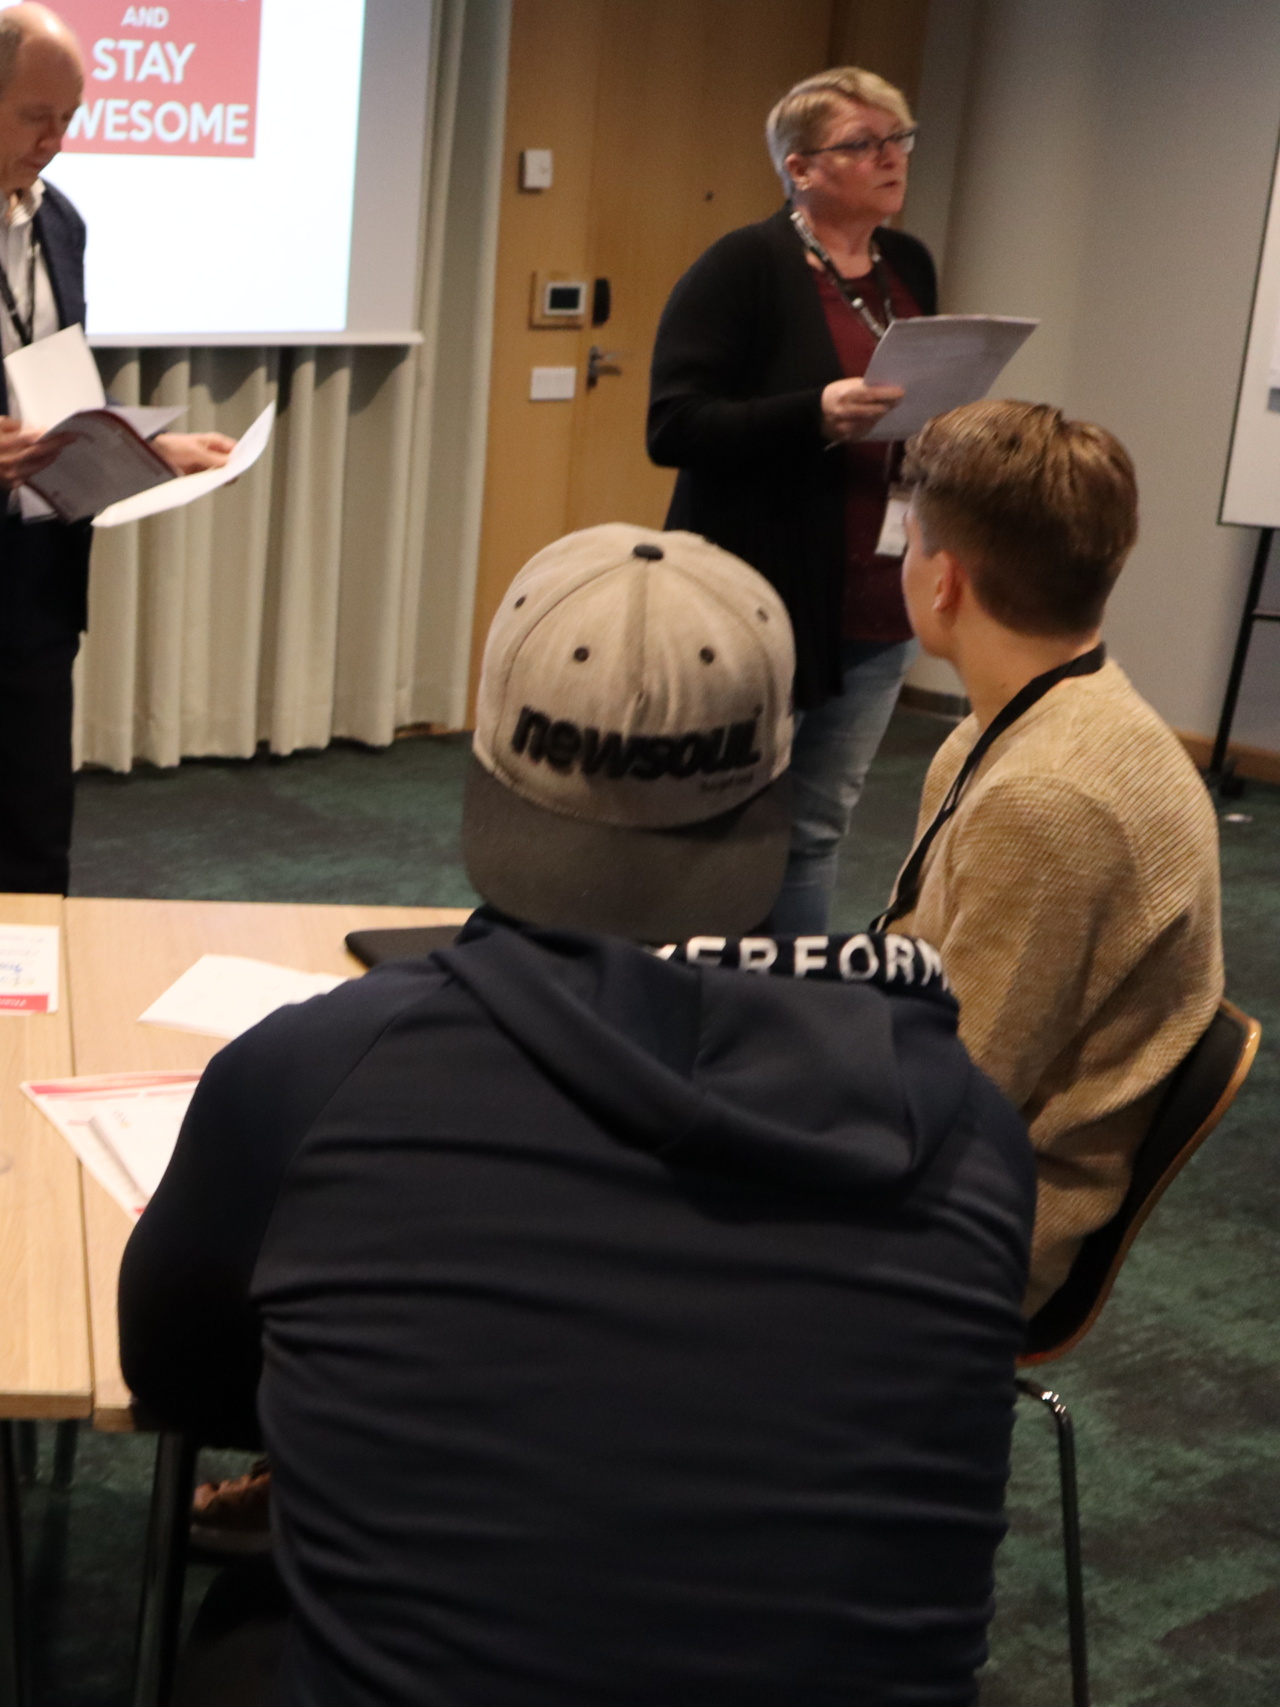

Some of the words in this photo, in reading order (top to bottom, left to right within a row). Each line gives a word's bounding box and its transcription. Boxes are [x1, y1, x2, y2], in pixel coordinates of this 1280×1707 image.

[120, 5, 169, 28] AND
[91, 37, 197, 84] STAY
[66, 98, 250, 145] WESOME
